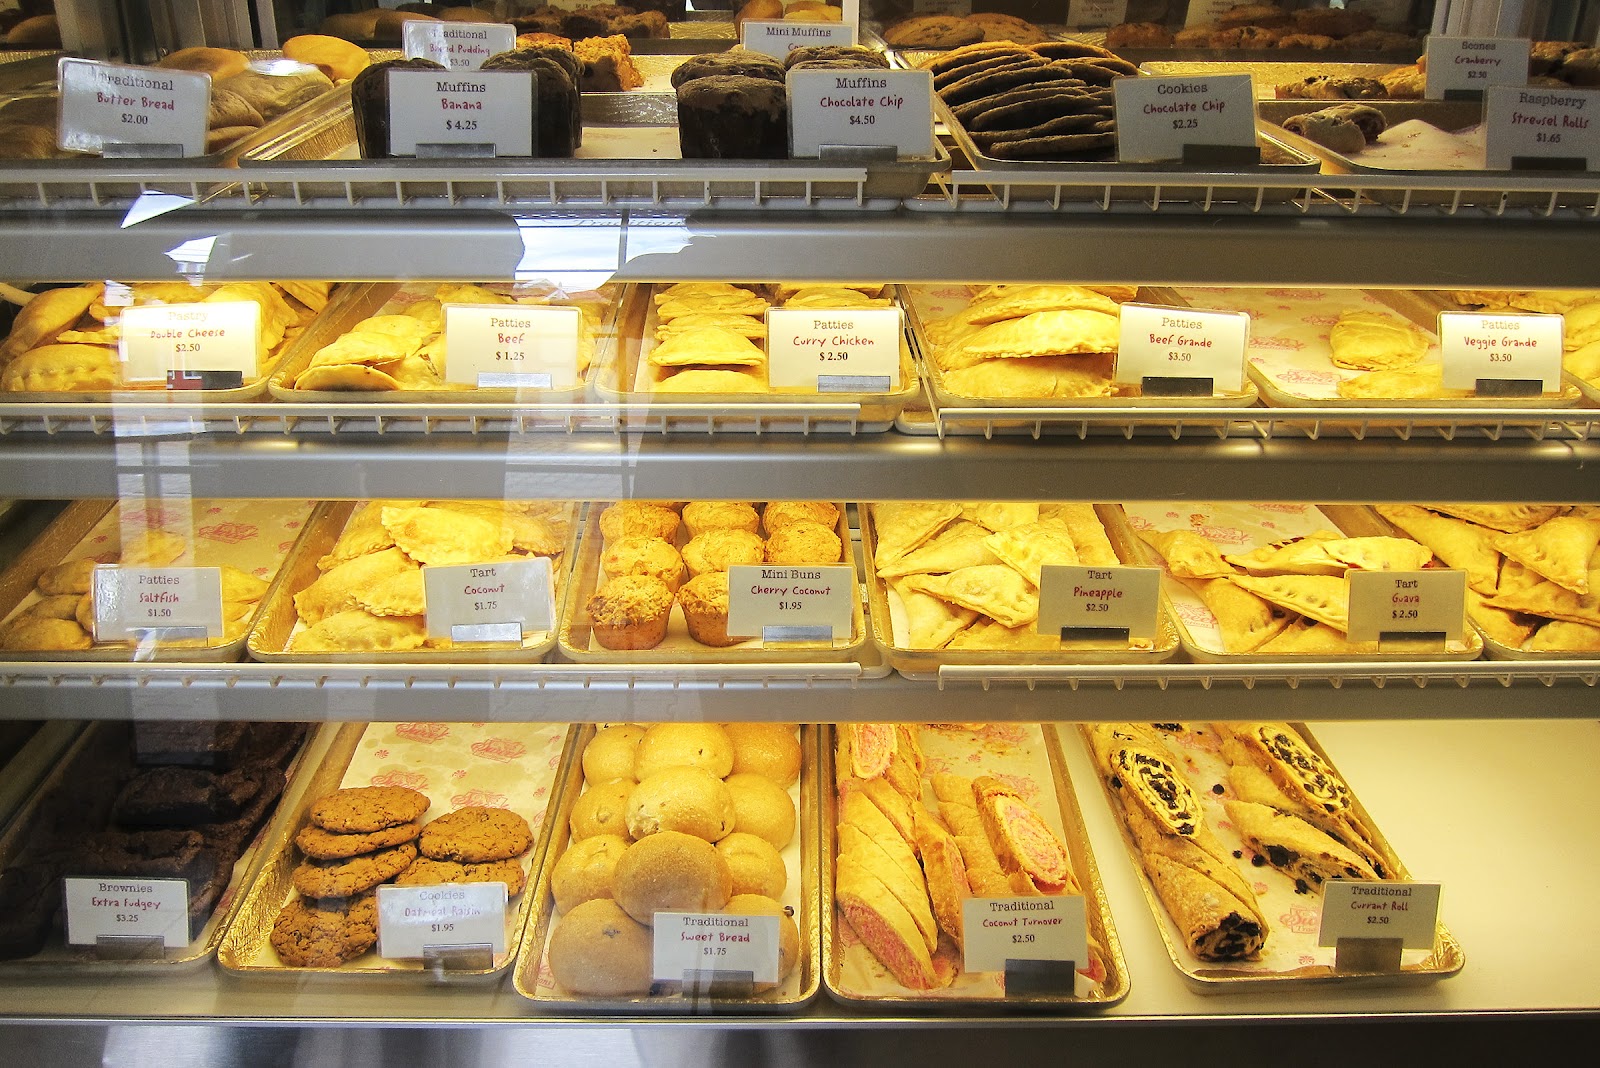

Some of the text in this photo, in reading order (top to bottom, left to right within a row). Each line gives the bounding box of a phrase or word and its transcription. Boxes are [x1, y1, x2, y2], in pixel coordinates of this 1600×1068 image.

[430, 29, 488, 40] Taditional
[766, 27, 832, 37] Mini Muffins
[457, 44, 491, 57] Pudding
[1461, 41, 1496, 51] Scones
[450, 58, 470, 67] $3.50
[1455, 55, 1501, 66] Cranberry
[1467, 70, 1487, 79] $2.50
[436, 82, 486, 92] Muffins
[836, 77, 887, 89] Muffins
[1157, 84, 1208, 95] Cookies
[97, 92, 174, 110] Butter Bread
[441, 98, 482, 110] Banana
[820, 94, 904, 110] Chocolate Chip
[1520, 92, 1586, 110] Raspberry
[1143, 99, 1226, 115] Chocolate Chip
[121, 113, 148, 125] $2.00
[850, 115, 876, 125] $4.50
[1512, 112, 1589, 129] Streusel Rolls
[1172, 119, 1198, 130] $2.25
[1536, 132, 1561, 143] $1.65
[168, 312, 208, 322] Pastry
[490, 318, 531, 328] Patties
[814, 320, 854, 330] Patties
[1161, 317, 1203, 330] Patties
[1482, 320, 1520, 330] Patties
[150, 329, 225, 339] Double Cheese
[498, 332, 525, 344] Beef
[793, 334, 874, 347] Curry Chicken
[1150, 334, 1212, 348] Beef Grande
[1464, 335, 1538, 350] Veggie Grande
[175, 344, 201, 353] $2.50
[1168, 352, 1192, 362] $3.50
[1490, 354, 1512, 362] $3.50
[470, 568, 496, 578] Tart
[761, 570, 821, 580] Mini Buns
[1088, 570, 1113, 580] Tart
[138, 575, 180, 585] Patties
[1396, 580, 1418, 588] Tart
[464, 584, 505, 594] Coconut
[750, 586, 831, 596] Cherry Coconut
[1074, 586, 1123, 600] Pineapple
[140, 592, 179, 602] Saltfish
[1392, 592, 1420, 603] Guava
[474, 601, 498, 610] $1.75
[780, 602, 802, 610] $1.95
[1086, 604, 1109, 612] $2.50
[148, 608, 172, 618] $1.50
[98, 882, 153, 893] Brownies
[1351, 886, 1412, 896] Traditional
[420, 890, 466, 900] Cookies
[92, 896, 120, 907] Extra
[990, 900, 1055, 912] Traditional
[1350, 901, 1408, 911] Currant Roll
[116, 914, 139, 922] $3.25
[682, 916, 749, 927] Traditional
[982, 918, 1063, 928] Coconut Turnover
[1367, 916, 1390, 924] $2.50
[431, 924, 454, 932] $1.95
[681, 932, 750, 942] Sweet Bread
[1012, 934, 1036, 944] $2.50
[704, 948, 727, 956] $1.75
